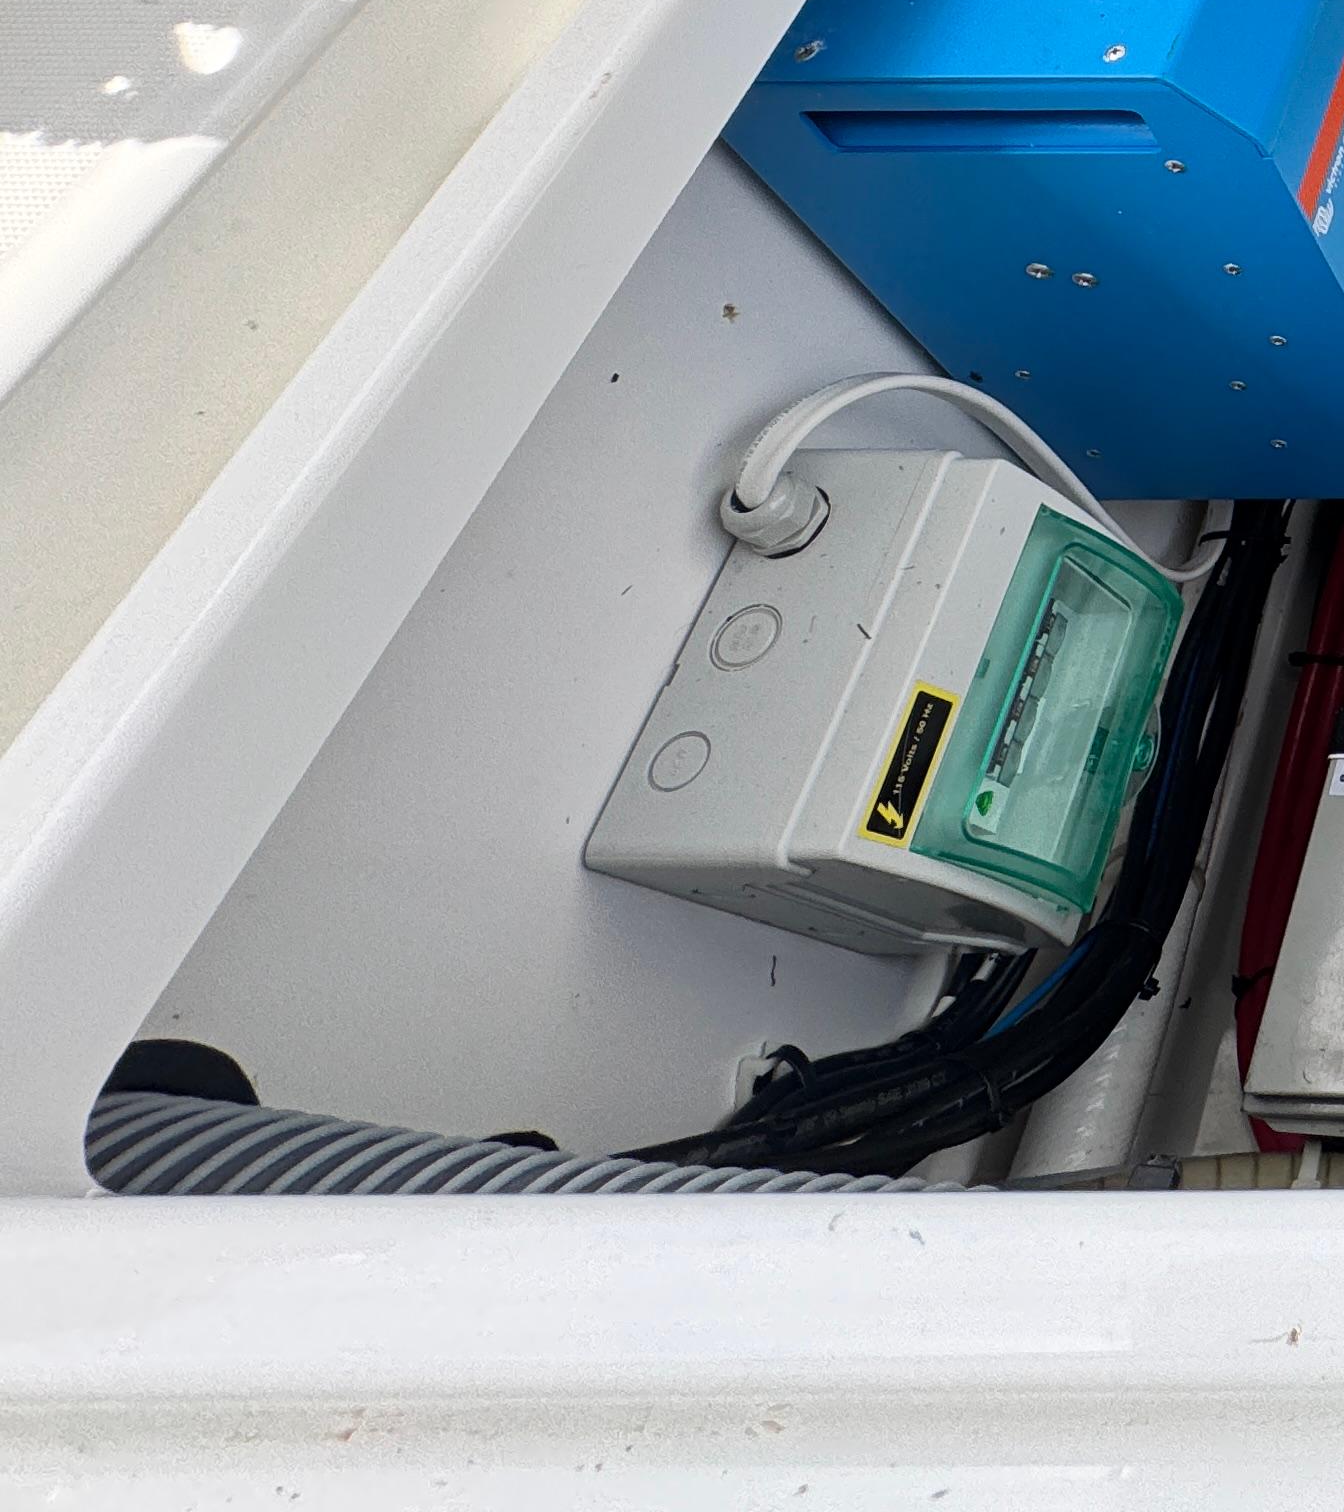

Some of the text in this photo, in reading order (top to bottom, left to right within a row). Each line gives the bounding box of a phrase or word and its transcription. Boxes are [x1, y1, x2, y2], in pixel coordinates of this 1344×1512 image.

[1326, 145, 1344, 194] victron
[901, 745, 918, 773] Volts
[923, 702, 934, 719] Hz
